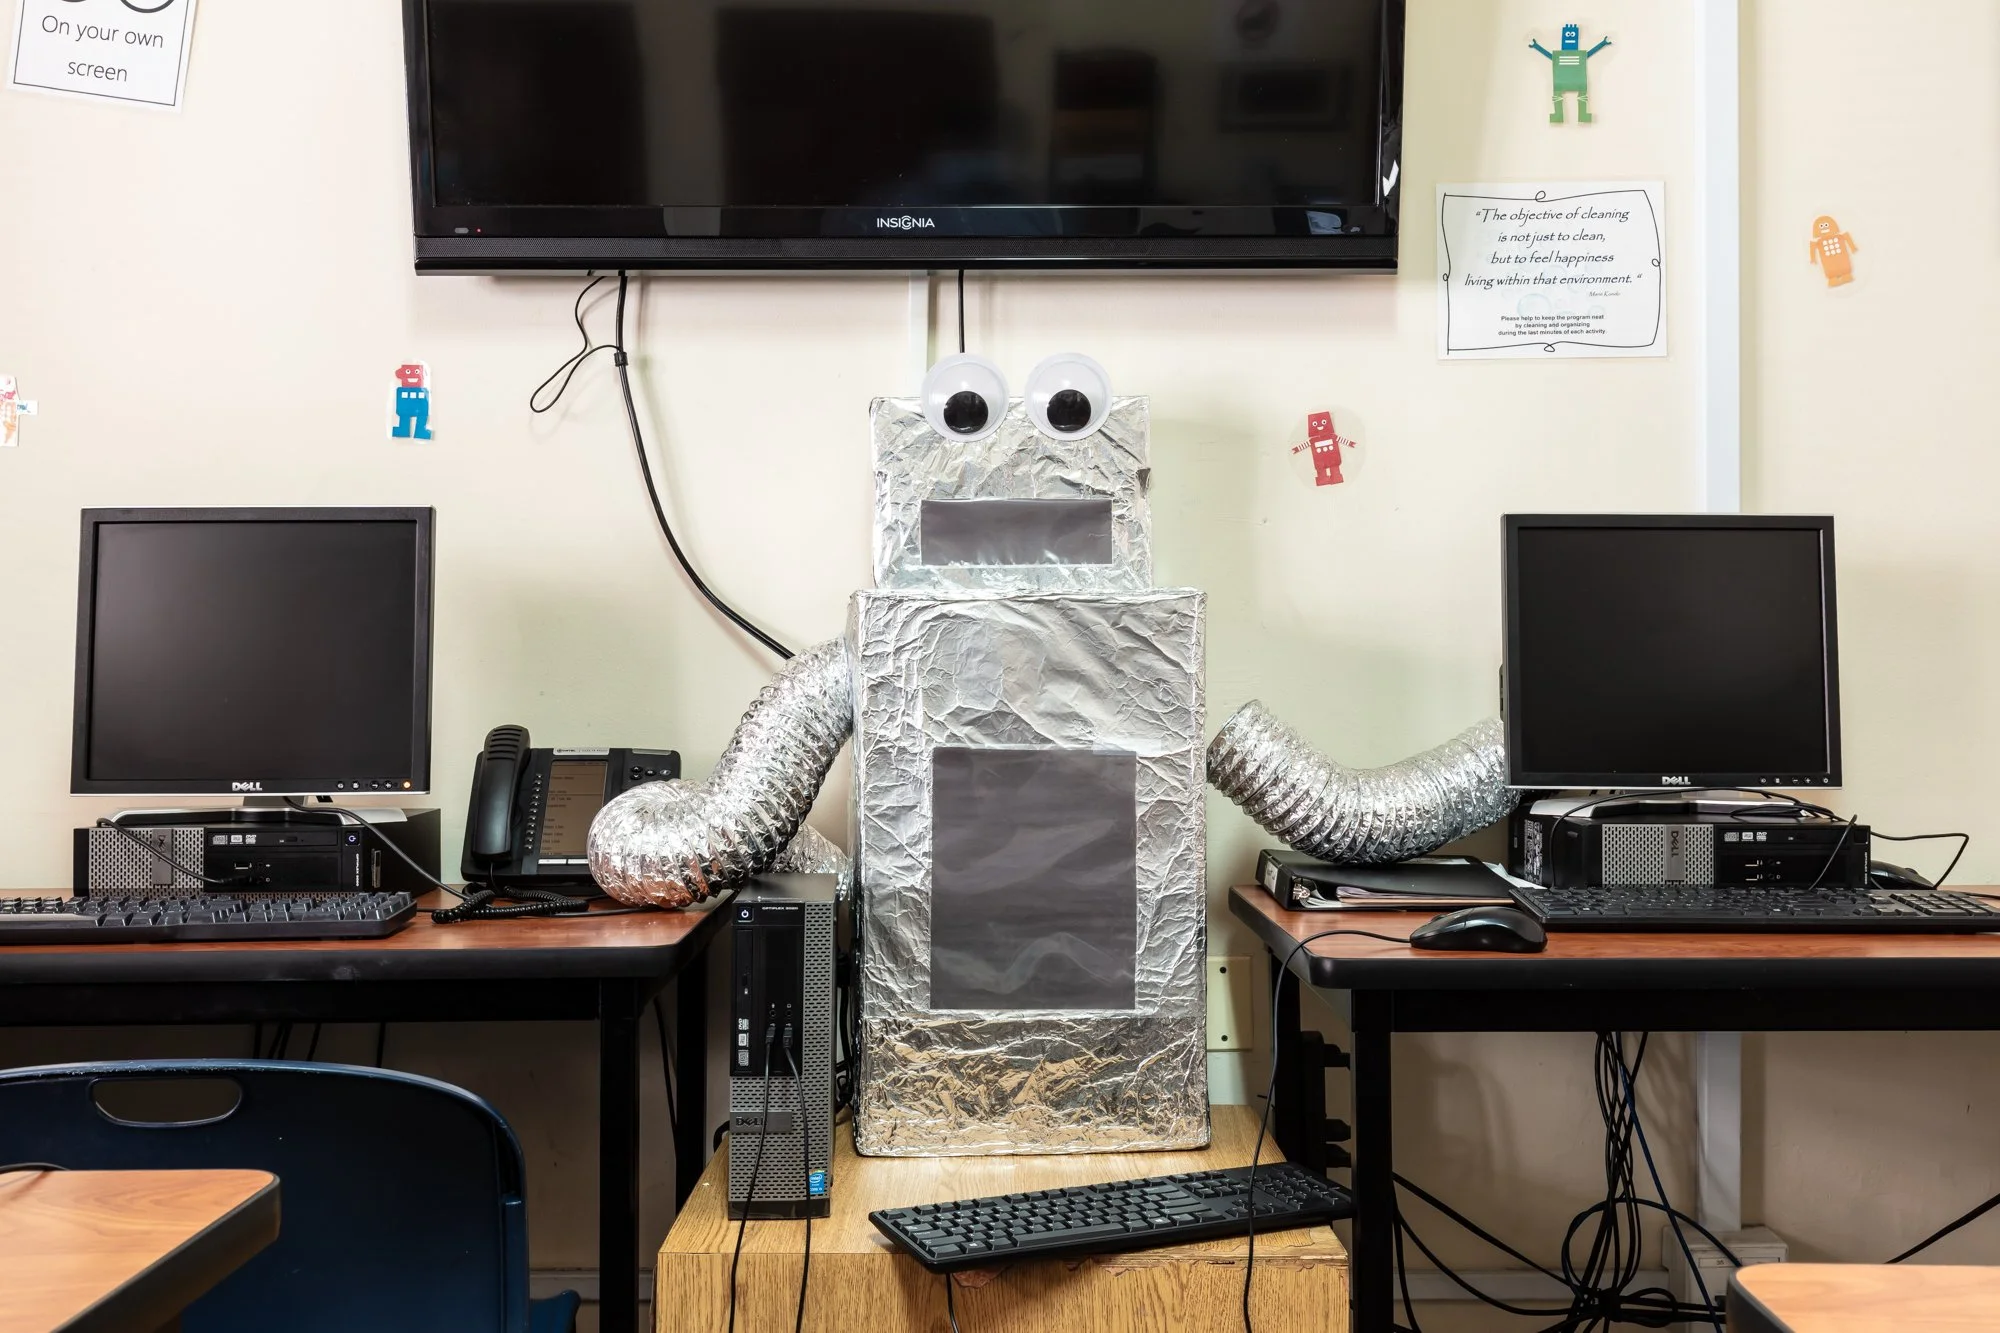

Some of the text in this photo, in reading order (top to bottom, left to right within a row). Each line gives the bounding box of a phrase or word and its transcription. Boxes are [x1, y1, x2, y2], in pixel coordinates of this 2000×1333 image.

[42, 15, 164, 48] On your own
[67, 61, 128, 82] screen
[876, 215, 936, 230] INSIGNIA
[1509, 207, 1564, 227] objective
[1565, 206, 1581, 221] of
[1581, 206, 1631, 222] cleaning
[1497, 228, 1606, 248] is not just to clean,
[1490, 250, 1615, 268] but to feel happiness
[1464, 273, 1495, 291] living
[1496, 274, 1531, 286] within
[1532, 272, 1558, 285] that
[1560, 321, 1591, 329] organizing
[231, 781, 263, 792] DELL
[1661, 776, 1692, 786] DELL
[1670, 830, 1680, 858] DELL
